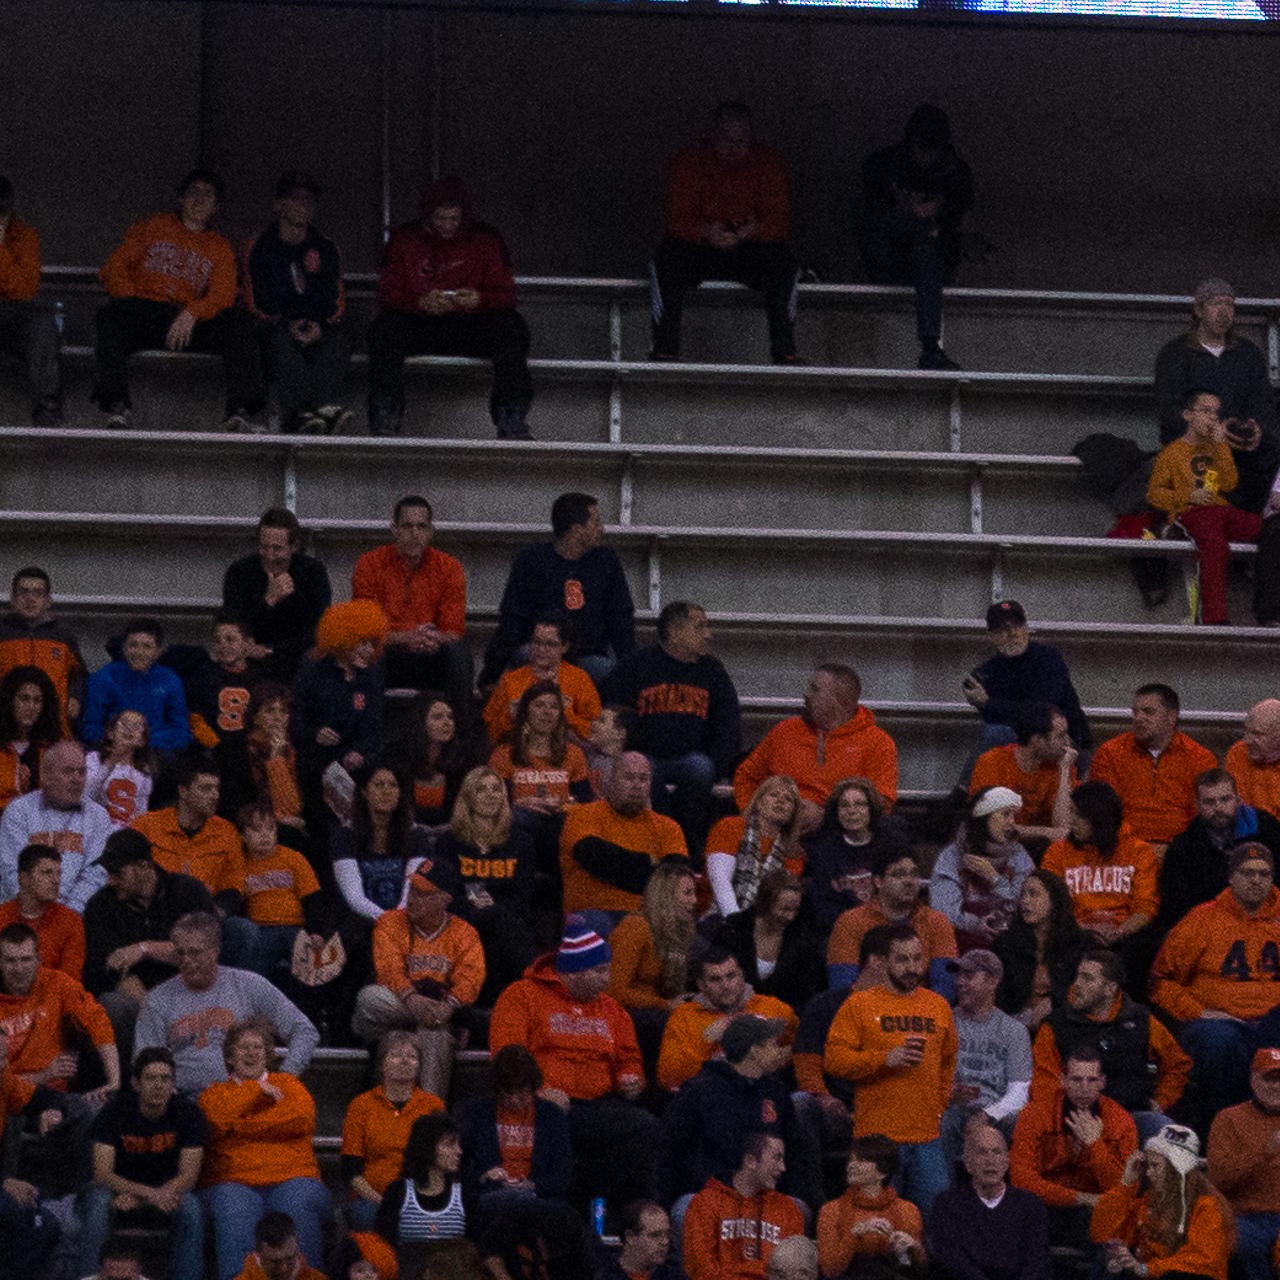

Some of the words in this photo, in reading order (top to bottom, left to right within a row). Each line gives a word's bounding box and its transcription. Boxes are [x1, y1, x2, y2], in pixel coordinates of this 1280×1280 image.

[217, 686, 251, 731] S
[107, 777, 138, 825] S
[1064, 865, 1137, 896] SYRACUS
[881, 1015, 937, 1035] CUSE
